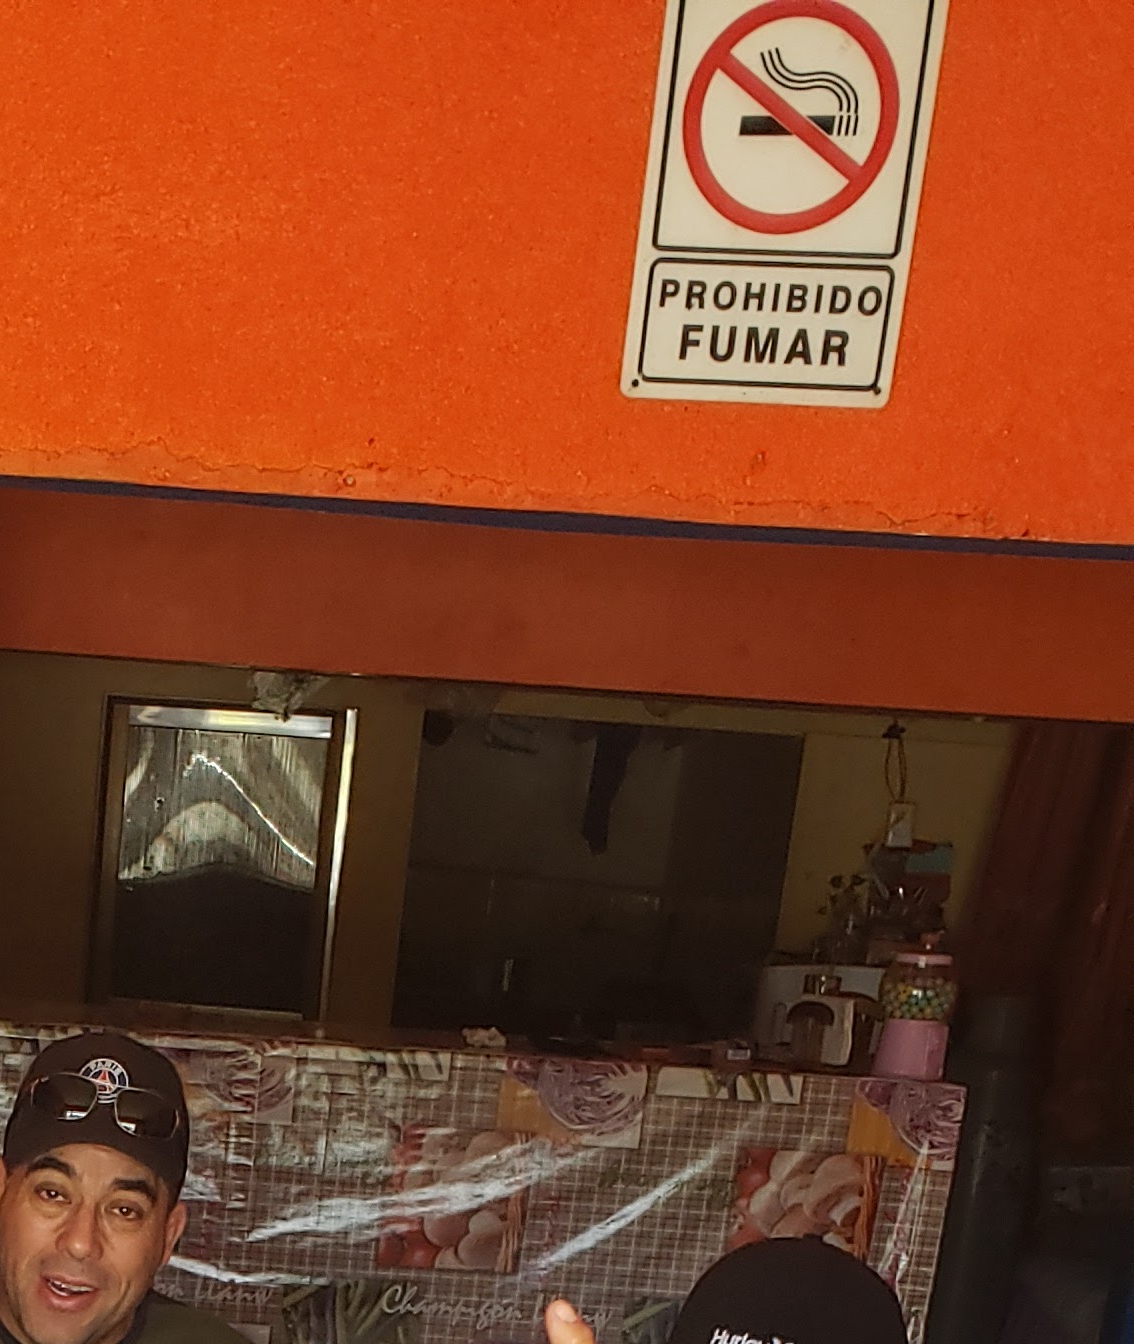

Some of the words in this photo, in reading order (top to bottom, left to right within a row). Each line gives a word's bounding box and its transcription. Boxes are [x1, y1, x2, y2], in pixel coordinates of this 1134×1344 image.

[658, 278, 884, 317] PROHIBIDO
[678, 324, 850, 367] FUMAR
[88, 1060, 124, 1077] PARIS
